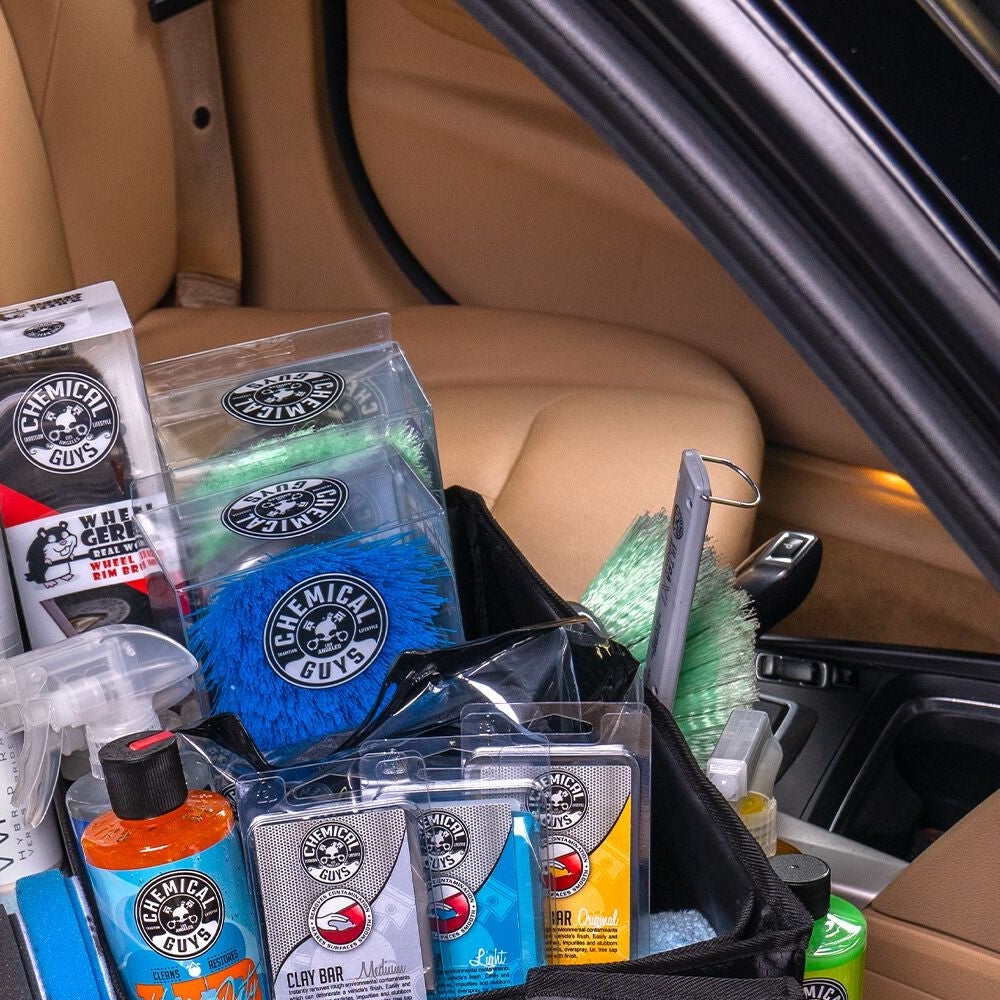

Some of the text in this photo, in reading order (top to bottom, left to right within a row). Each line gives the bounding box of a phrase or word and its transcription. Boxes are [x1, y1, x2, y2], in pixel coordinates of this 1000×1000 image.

[245, 372, 309, 390] GUYS
[21, 380, 109, 433] CHEMICAL
[234, 381, 335, 419] CHEMICAL
[49, 442, 99, 467] GUYS
[243, 480, 308, 503] GUYS
[236, 488, 337, 533] CHEMICAL
[90, 555, 135, 571] WHEEL
[93, 545, 121, 558] REAL
[92, 567, 118, 581] RIM
[274, 583, 376, 647] CHEMICAL
[300, 647, 365, 679] GUYS
[303, 825, 360, 857] CHEMICAL
[319, 866, 351, 882] GUYS
[143, 878, 217, 923] CHEMICAL
[309, 890, 371, 920] REMOVES CONTAMINATION
[577, 907, 619, 933] Original
[163, 928, 212, 953] GUYS
[326, 941, 359, 951] SURFACES
[358, 919, 373, 943] SMOOTH
[208, 950, 239, 970] RESTORES
[468, 947, 508, 975] Light
[152, 969, 181, 981] CLEANS
[287, 969, 315, 989] CLAY
[319, 966, 344, 984] BAR
